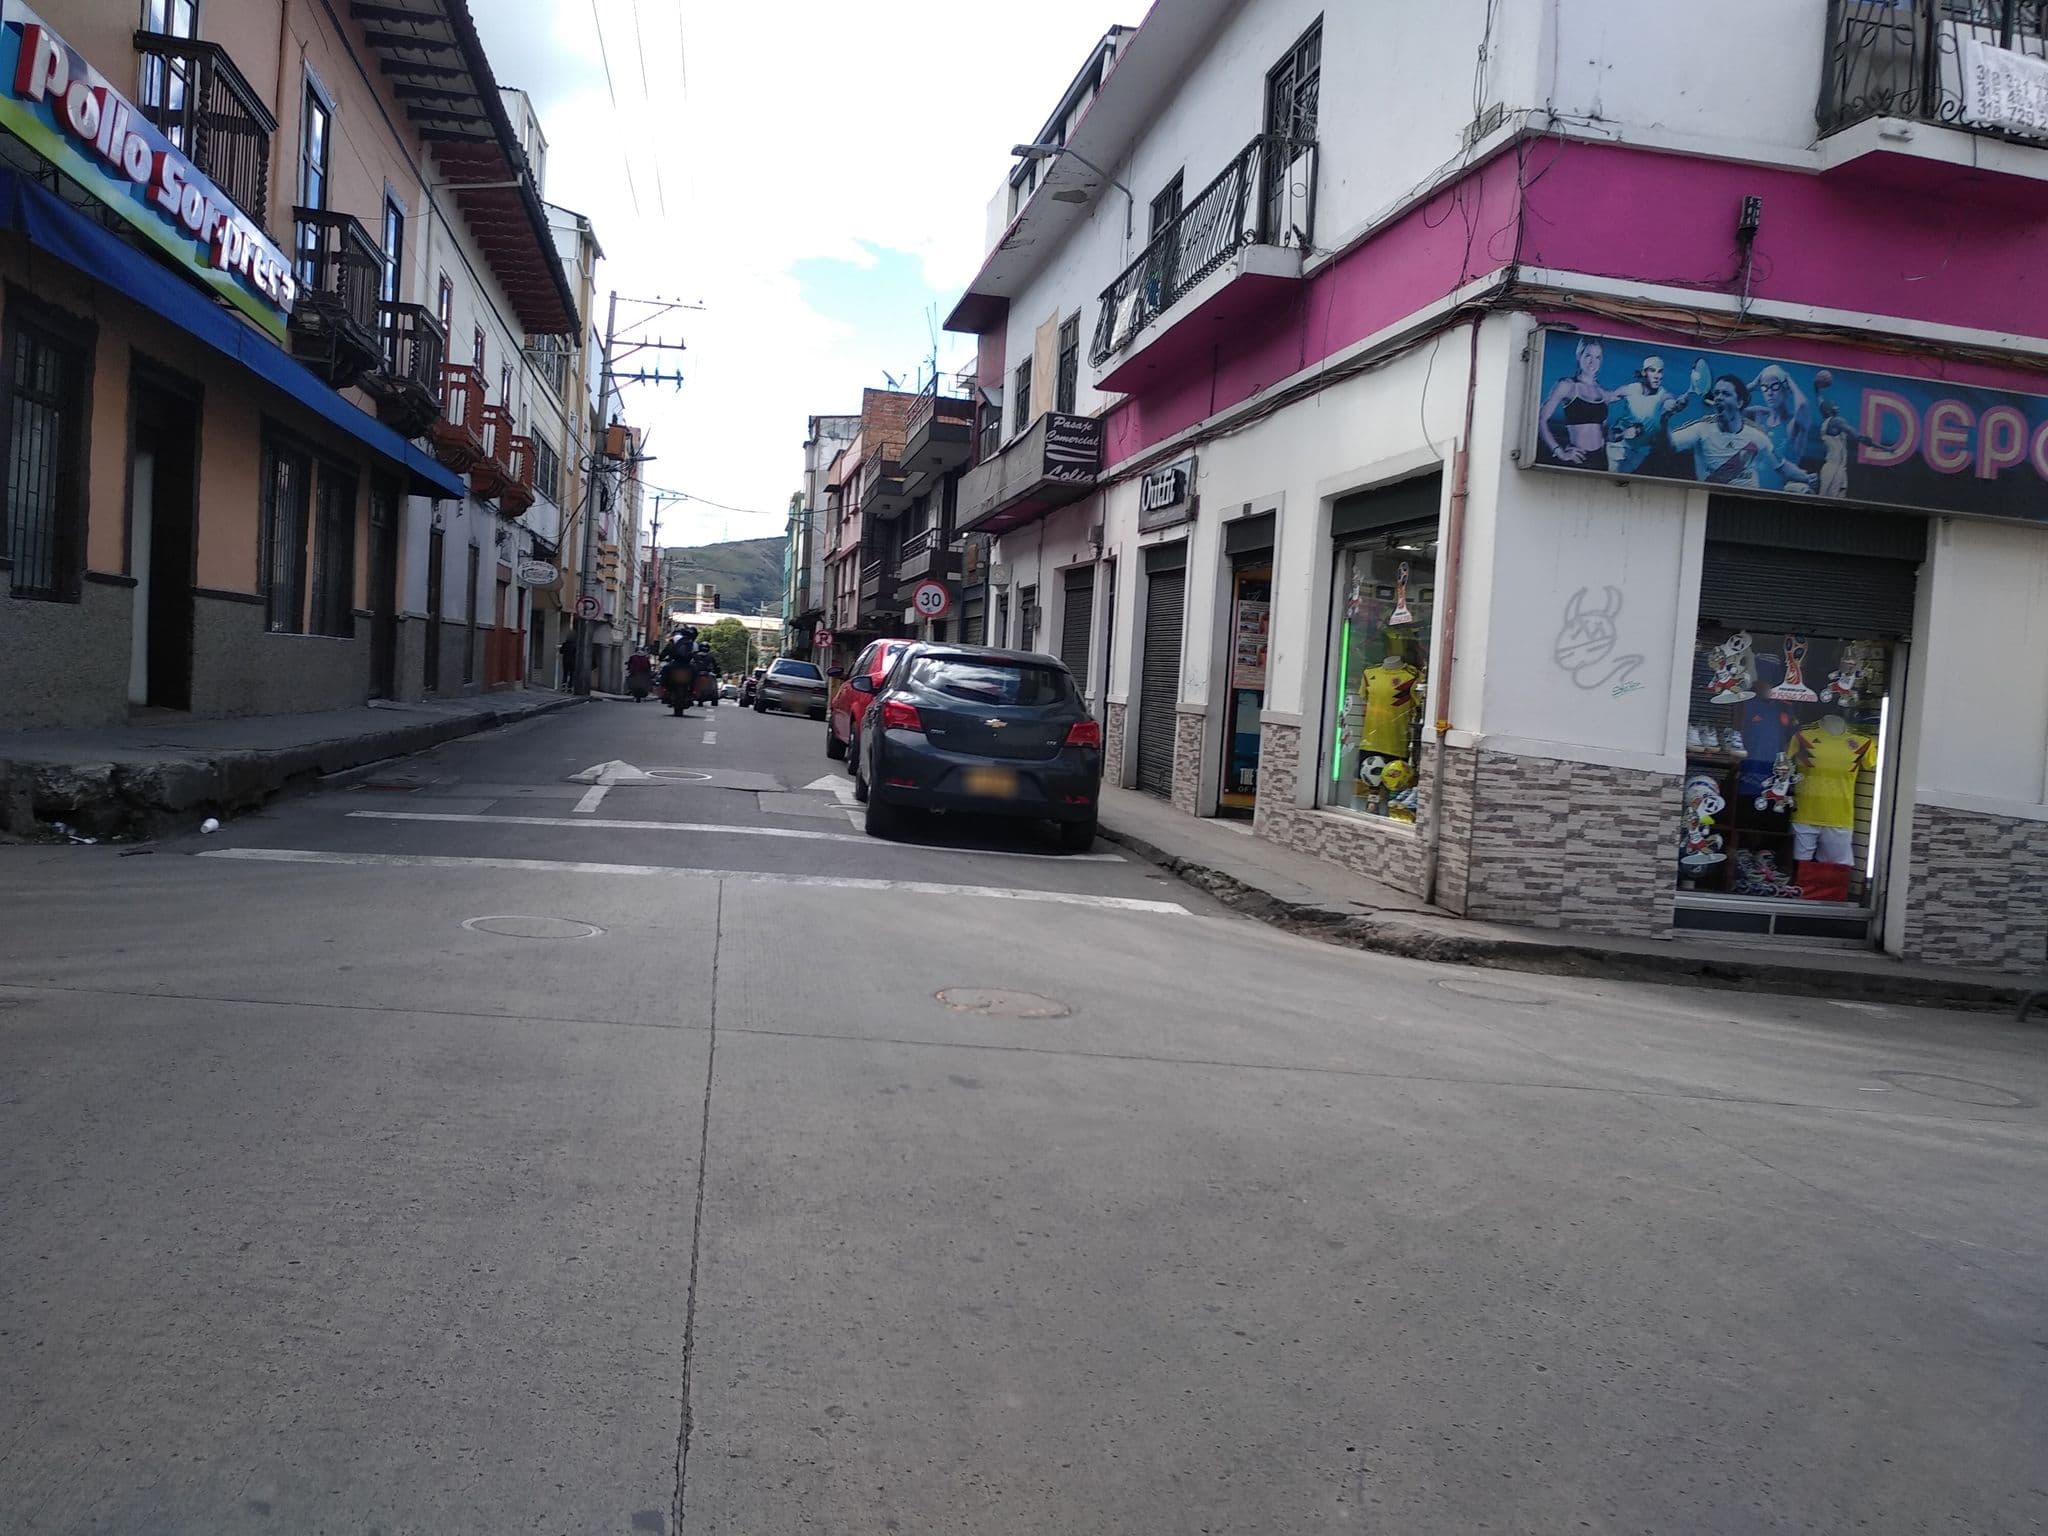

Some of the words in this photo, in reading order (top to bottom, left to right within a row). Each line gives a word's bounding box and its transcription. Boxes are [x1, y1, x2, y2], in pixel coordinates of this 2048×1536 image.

[1053, 416, 1093, 433] Pasaje
[1046, 430, 1099, 446] Comercial
[1142, 468, 1176, 512] Outfit
[583, 599, 596, 616] P
[920, 592, 941, 607] 30
